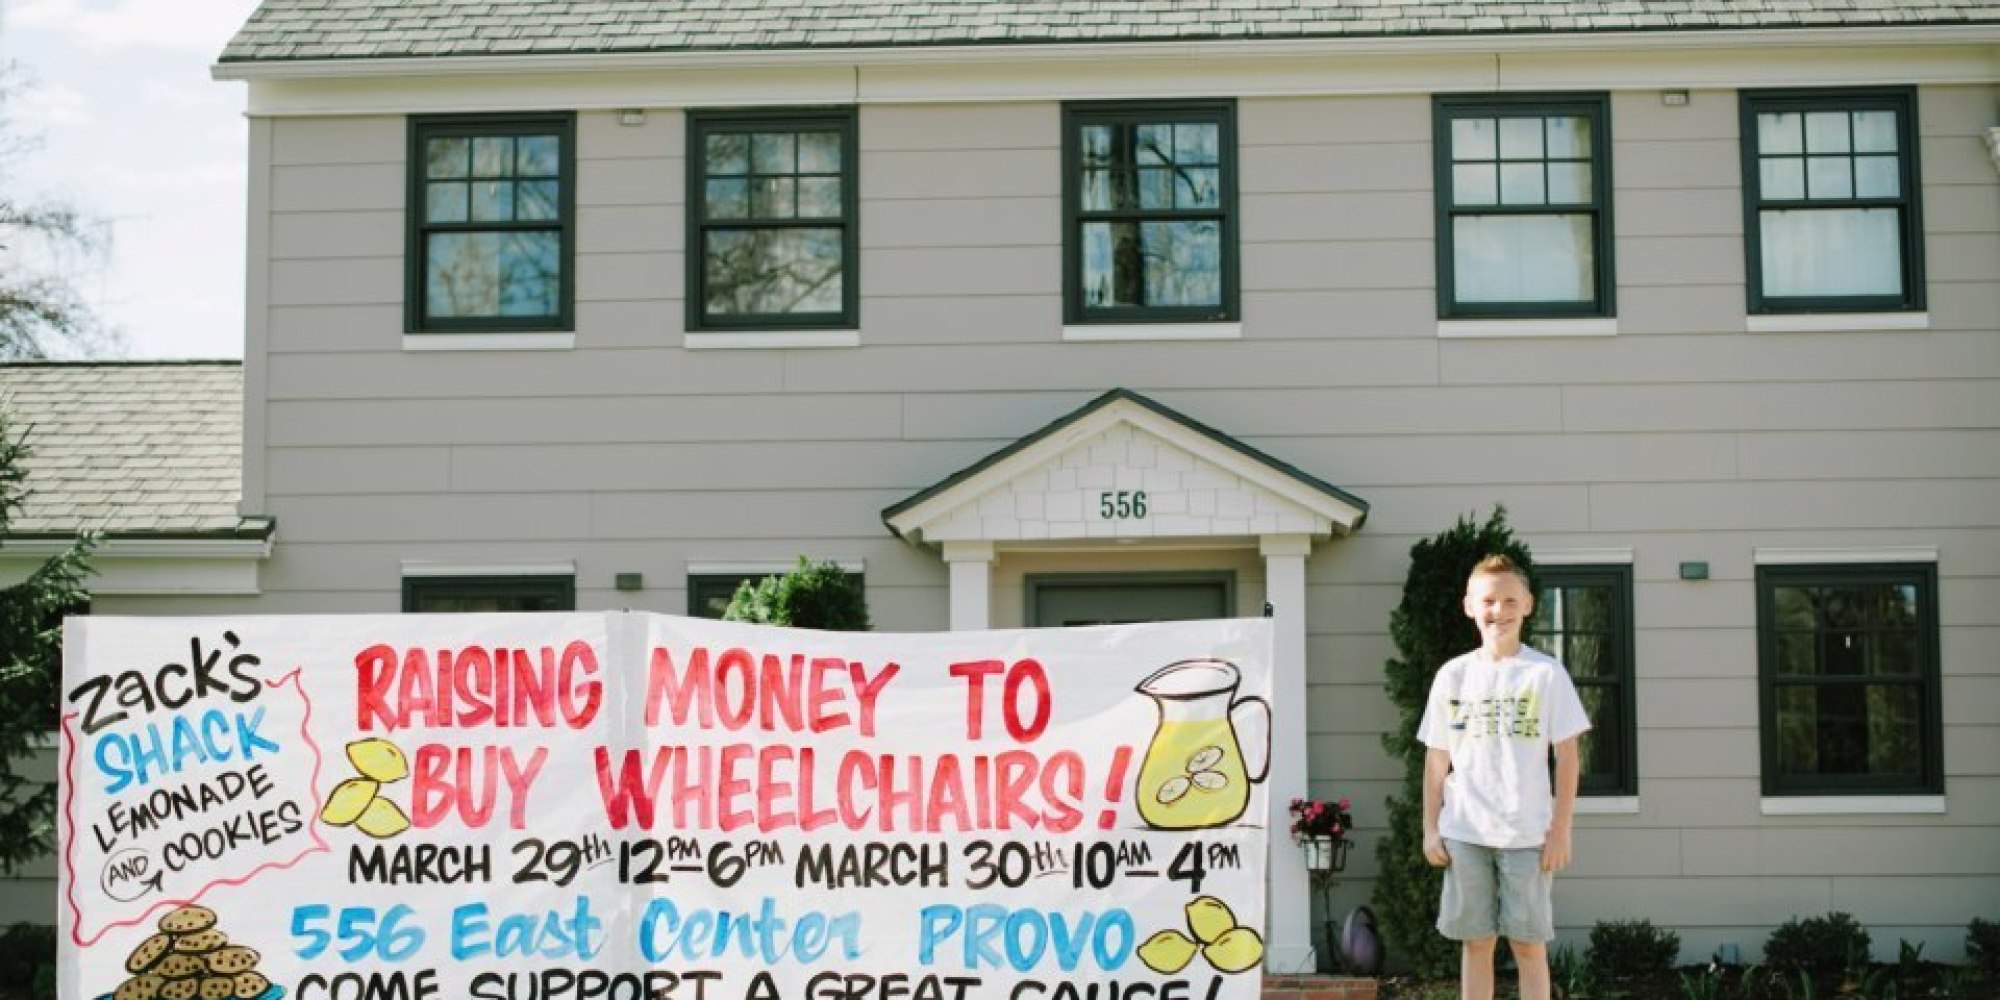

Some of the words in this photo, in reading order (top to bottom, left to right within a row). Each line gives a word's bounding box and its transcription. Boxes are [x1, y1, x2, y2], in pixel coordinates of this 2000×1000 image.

[1101, 491, 1147, 519] 556
[354, 640, 603, 732] RAISING
[645, 648, 900, 736] MONEY
[949, 658, 1051, 743] TO
[94, 706, 280, 795] SHACK
[411, 743, 549, 830] BUY
[594, 744, 1134, 834] WHEELCHAIRS!
[93, 764, 275, 854] LEMONADE
[108, 855, 150, 887] AND
[162, 800, 303, 872] COOKIES
[348, 843, 492, 885] MARCH
[795, 841, 949, 890] MARCH
[289, 904, 427, 963] 556
[451, 894, 603, 961] East
[640, 896, 863, 966] Center
[919, 905, 1135, 971] PROVO
[295, 968, 438, 1000] COME
[469, 968, 723, 1000] SUPPORT
[744, 970, 782, 1000] A
[805, 970, 982, 1000] GREAT
